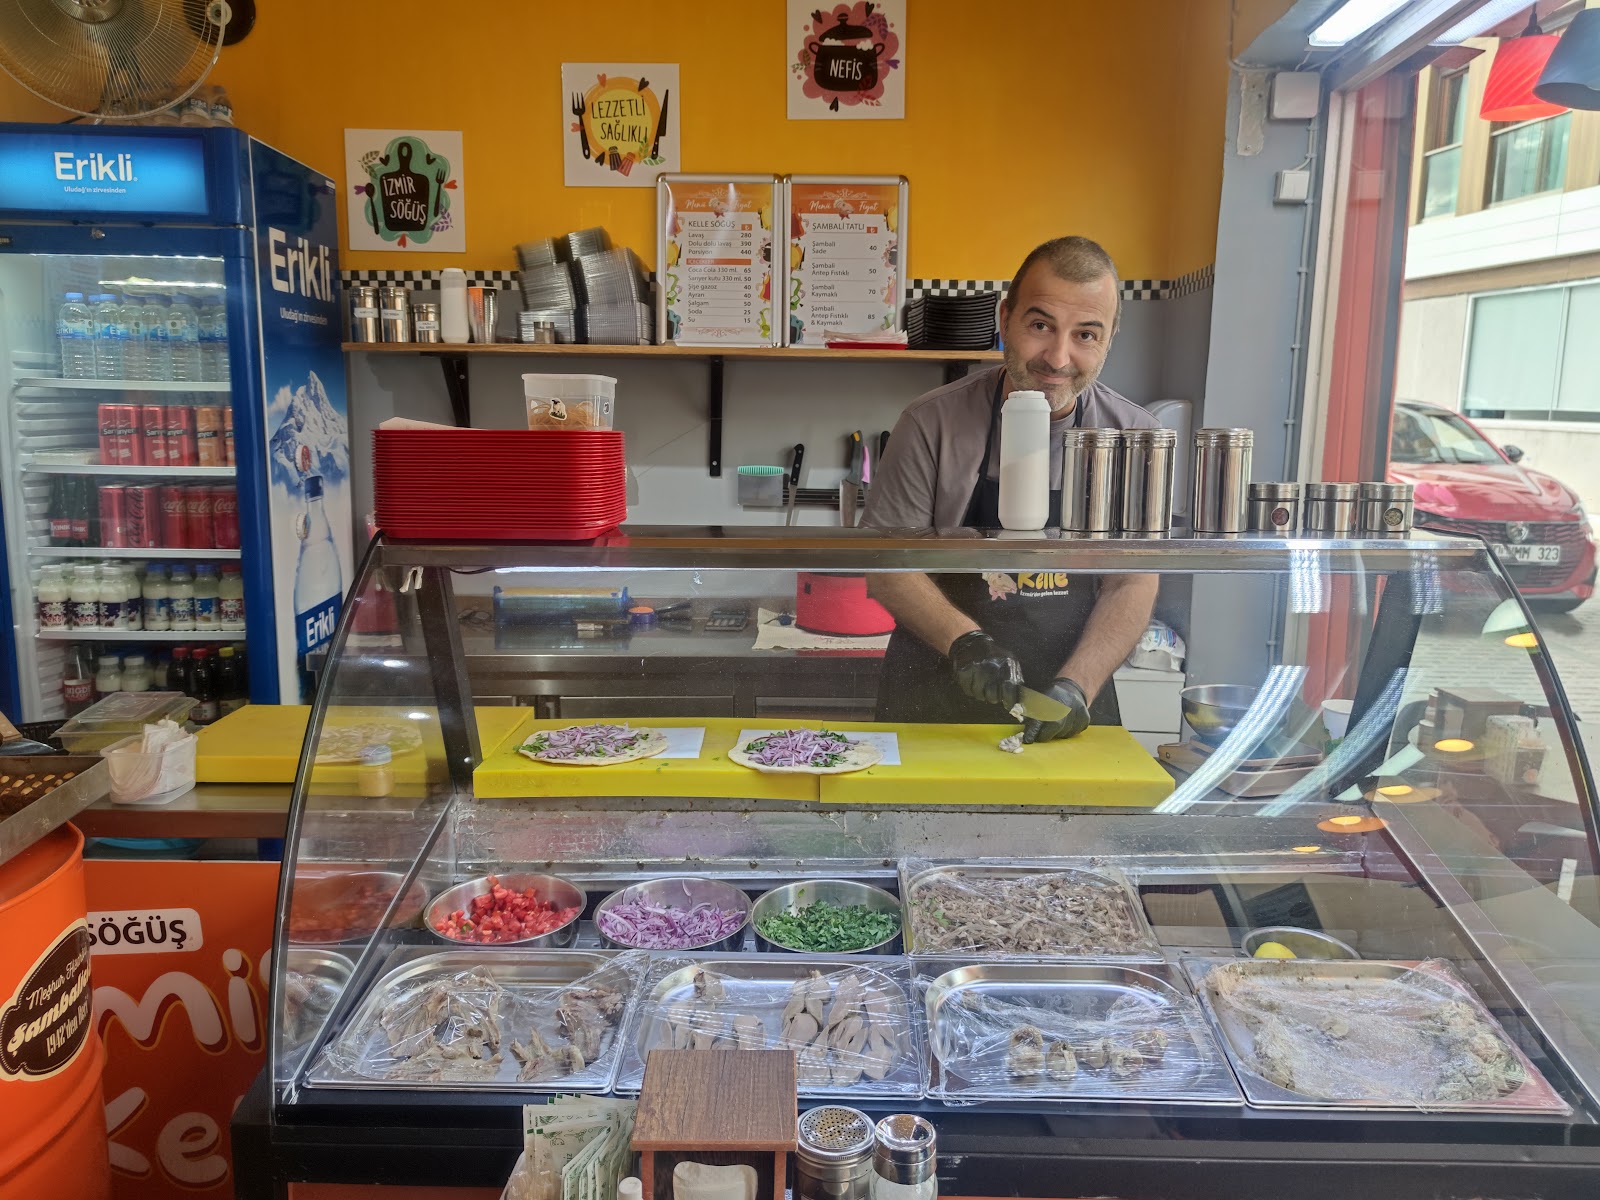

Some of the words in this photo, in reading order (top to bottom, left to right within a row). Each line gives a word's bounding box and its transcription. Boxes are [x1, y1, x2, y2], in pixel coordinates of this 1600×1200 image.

[829, 58, 863, 81] NEFİS
[591, 95, 646, 119] LEZZETLİ
[600, 120, 648, 144] SAĞLIKLI
[54, 151, 133, 182] Erikli
[382, 173, 416, 197] İZMİR
[389, 198, 427, 225] SÖĞÜŞ
[686, 200, 707, 210] Menü
[809, 201, 831, 211] Menü
[859, 201, 879, 214] Fiyat
[711, 219, 736, 229] SÖĞÜŞ
[812, 222, 845, 231] ŞAMBALİ
[268, 226, 332, 302] Erikli
[1538, 547, 1559, 560] 323
[306, 606, 335, 648] Erikli
[26, 975, 65, 1010] Meşhur
